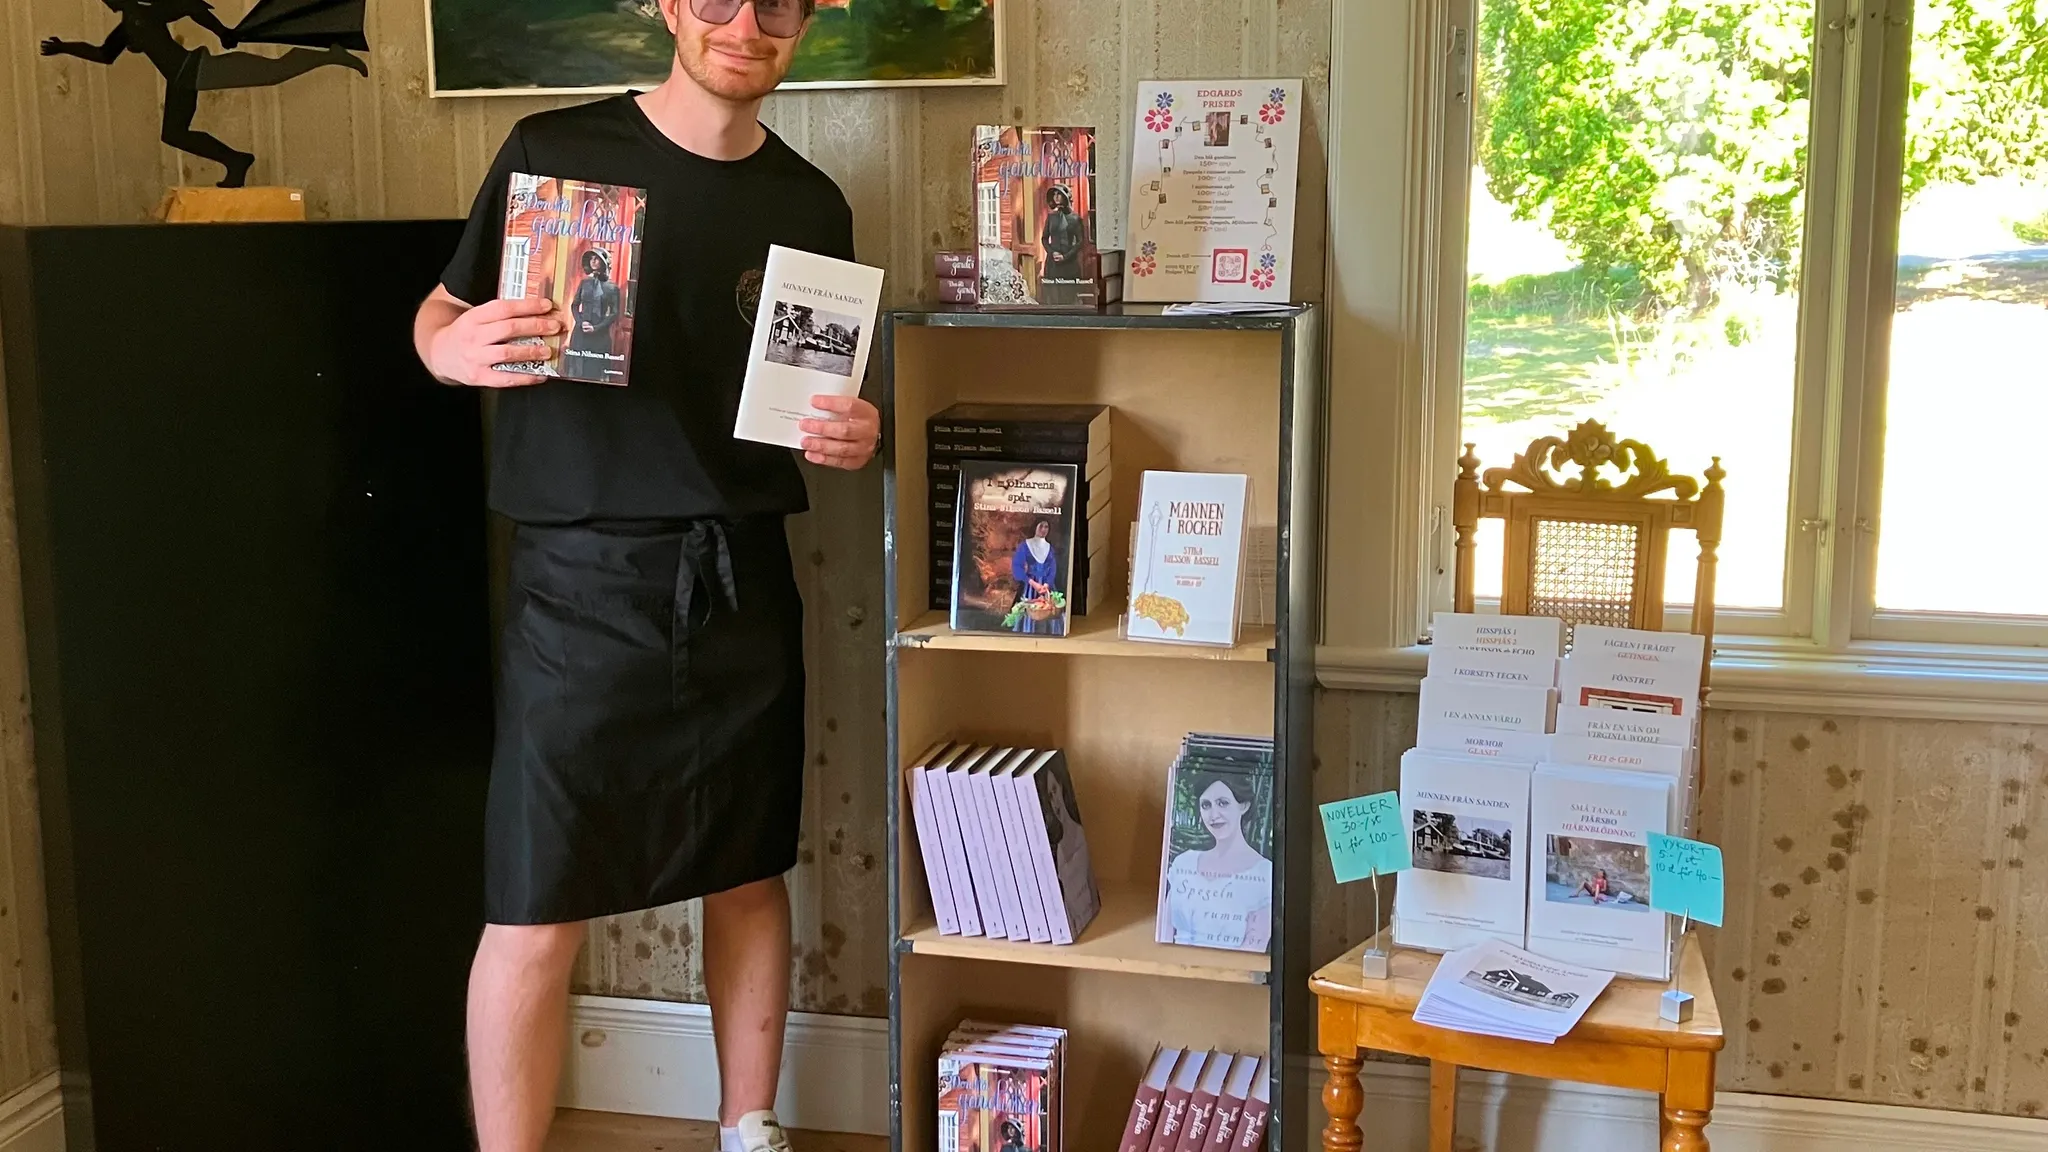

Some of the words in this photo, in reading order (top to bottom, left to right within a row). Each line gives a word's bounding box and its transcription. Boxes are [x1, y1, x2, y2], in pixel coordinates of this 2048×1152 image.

[1197, 89, 1243, 98] EDGARDS
[1203, 100, 1236, 108] PRISER
[781, 282, 812, 294] MINNEN
[814, 288, 833, 298] FRÅN
[834, 294, 864, 305] SANDEN
[987, 477, 992, 487] I
[1008, 492, 1032, 504] spår
[974, 502, 996, 511] Stina
[1169, 501, 1224, 520] MANNEN
[1167, 519, 1171, 534] I
[1178, 519, 1223, 536] ROCKEN
[1476, 627, 1511, 635] HISSPJÄS
[1459, 669, 1494, 678] KORSETS
[1497, 672, 1529, 680] TECKEN
[1612, 673, 1656, 685] FÖNSTRET
[1462, 713, 1492, 721] ANNAN
[1494, 715, 1522, 724] VÄRLD
[1588, 721, 1610, 730] FRÅN
[1627, 724, 1643, 733] VÄN
[1465, 738, 1503, 748] MORMOR
[1587, 730, 1626, 740] VIRGINIA
[1630, 735, 1660, 744] WOOLF
[1468, 748, 1499, 756] GLASET
[1618, 756, 1642, 765] GERD
[1416, 790, 1450, 801] MINNEN
[1452, 796, 1474, 804] FRÅN
[1476, 799, 1510, 808] SANDEN
[1326, 799, 1392, 821] NOVELLER
[1570, 803, 1589, 812] SMÅ
[1592, 806, 1628, 816] TANKAR
[1580, 814, 1617, 825] FJÄRSBO
[1562, 822, 1636, 838] HJÄRNBLÖDNING
[1334, 840, 1343, 853] 4
[1348, 836, 1364, 854] för
[1663, 839, 1712, 856] VYKORT
[1656, 862, 1665, 872] 10
[1677, 866, 1693, 880] för
[1177, 879, 1233, 901] Spegeln
